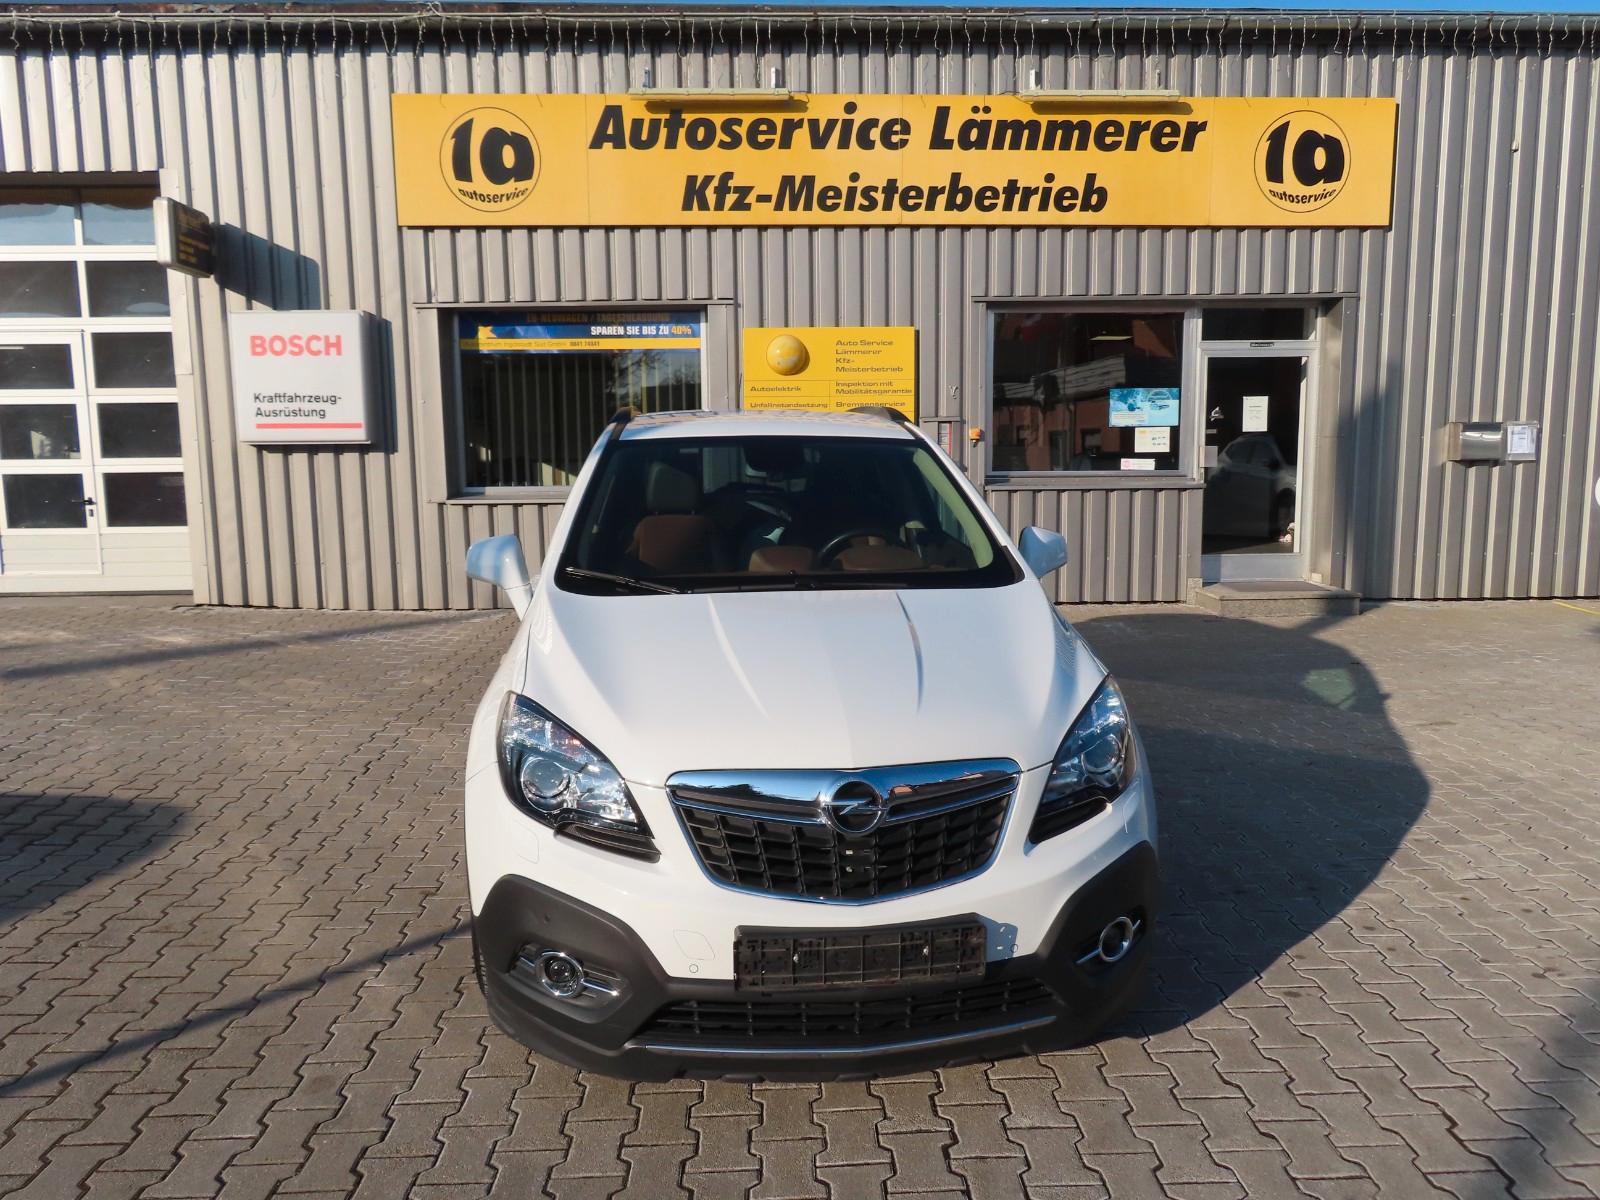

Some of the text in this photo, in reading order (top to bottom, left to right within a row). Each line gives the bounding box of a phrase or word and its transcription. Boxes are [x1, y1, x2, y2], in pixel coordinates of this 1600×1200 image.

[589, 102, 1207, 153] Autoservice Lämmerer
[451, 117, 535, 186] 1a
[1265, 119, 1345, 187] 1a
[458, 186, 528, 204] autoservice
[681, 172, 1108, 213] Kfz-Meisterbetrieb
[1268, 187, 1338, 205] autoservice
[591, 326, 692, 335] SPAREN SIE BIS ZU 40%
[249, 335, 343, 357] BOSCH
[836, 380, 878, 388] Inspektion
[836, 388, 913, 396] Mobilitätsgarantie
[253, 393, 342, 405] Kraftfahrzeug-
[255, 407, 326, 419] Ausrüstung
